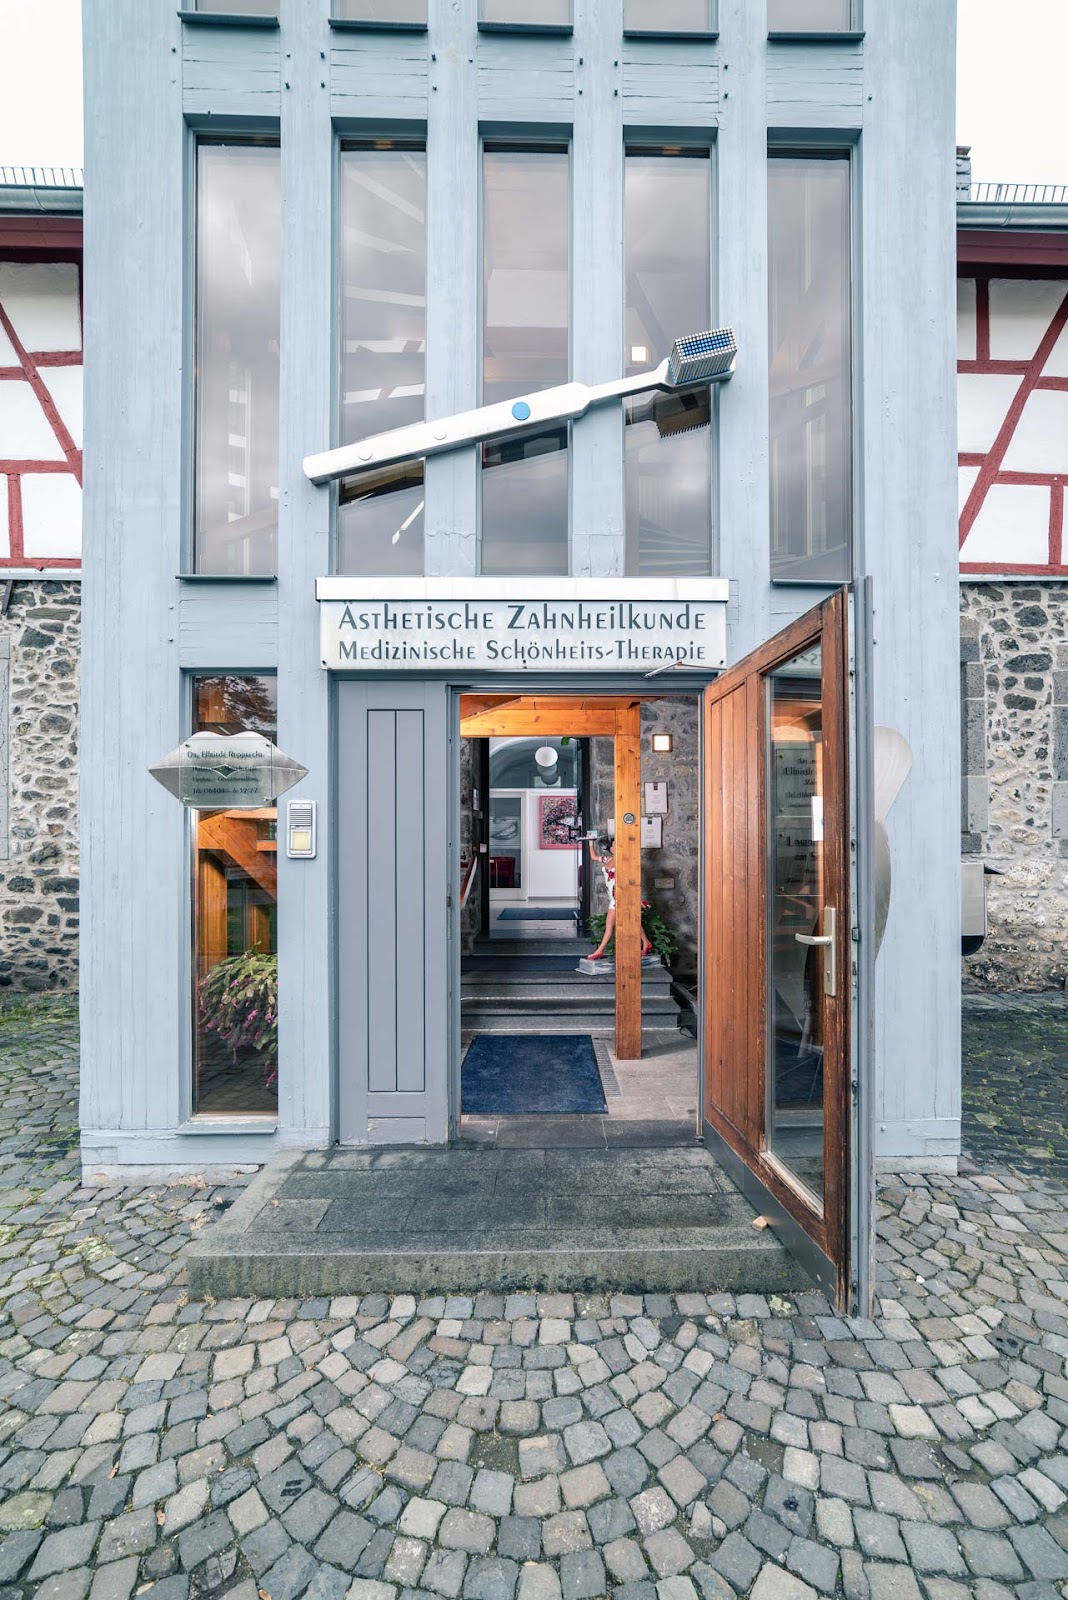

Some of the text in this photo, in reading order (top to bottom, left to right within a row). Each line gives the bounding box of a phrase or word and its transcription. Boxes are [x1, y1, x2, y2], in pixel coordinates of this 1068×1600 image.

[338, 601, 706, 630] Ästhetische Zahnheilkunde
[339, 638, 706, 661] Medizinische Schönheits-Therapie
